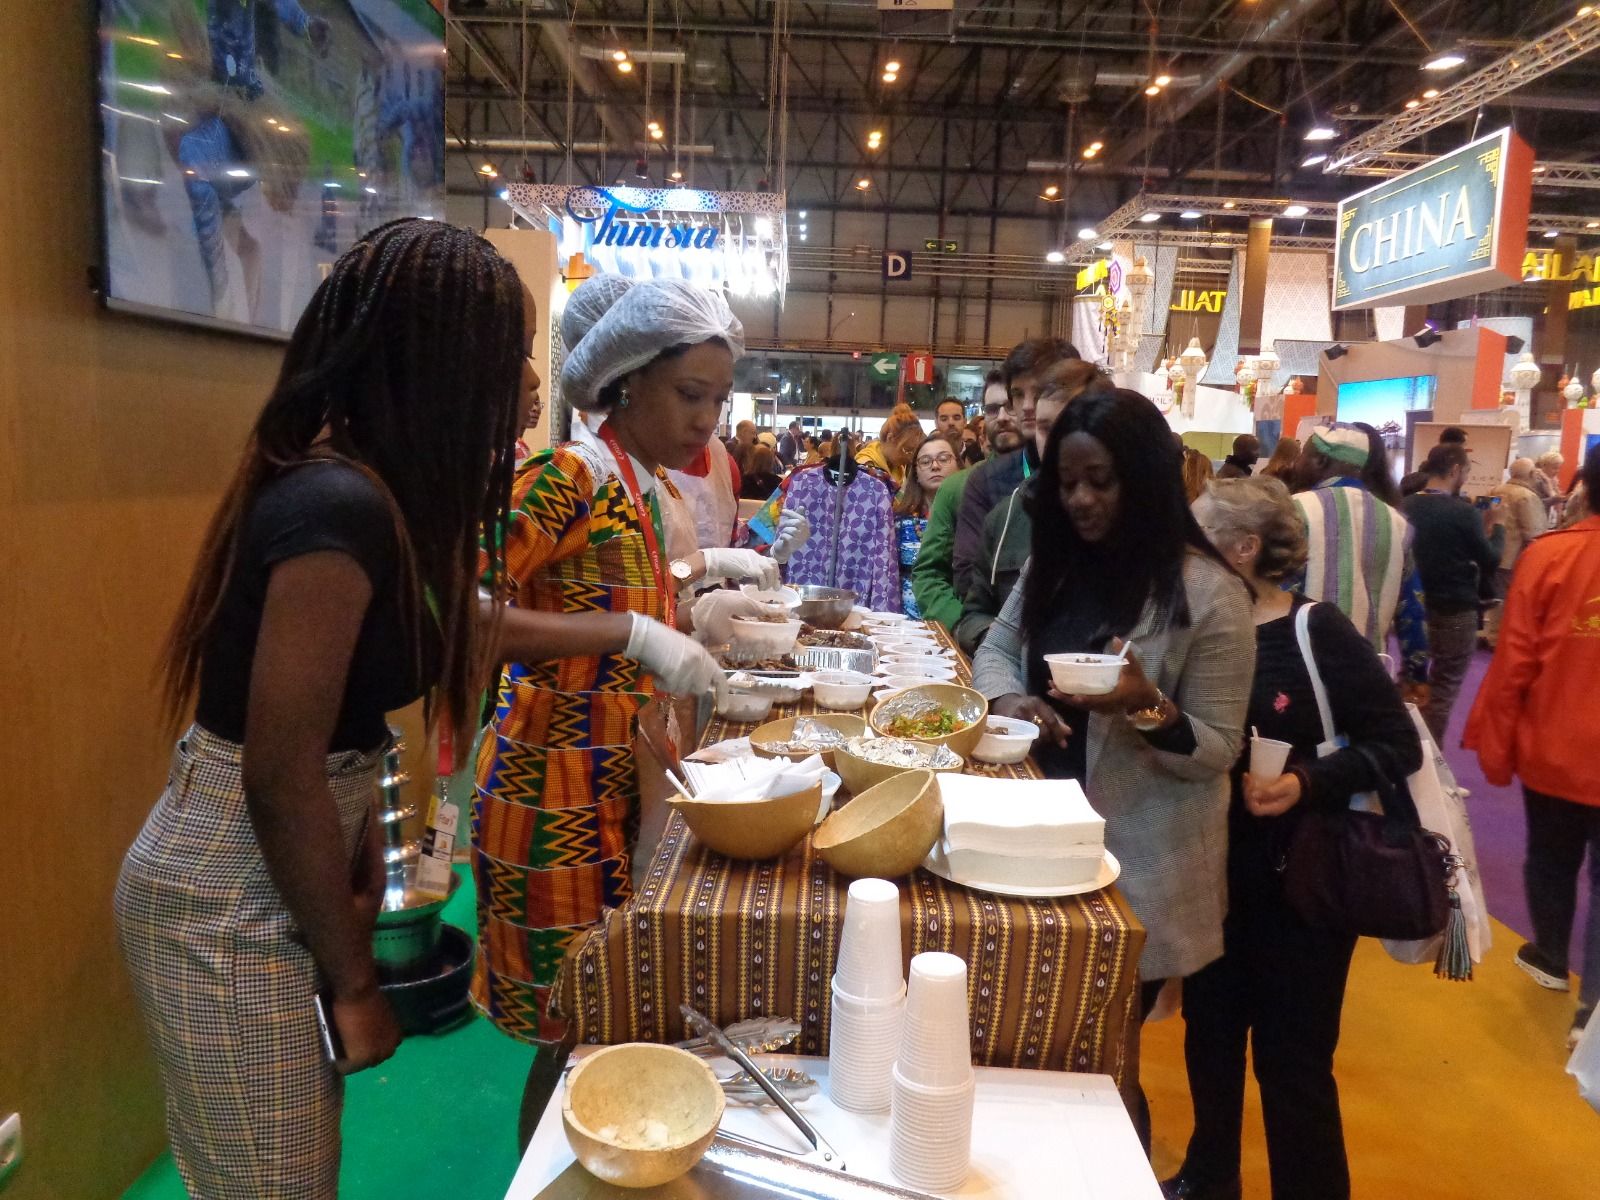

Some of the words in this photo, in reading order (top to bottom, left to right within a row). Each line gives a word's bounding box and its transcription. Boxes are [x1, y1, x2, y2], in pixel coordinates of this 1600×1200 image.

[566, 185, 719, 248] Tunisia
[1349, 184, 1476, 273] CHINA
[887, 255, 907, 277] D
